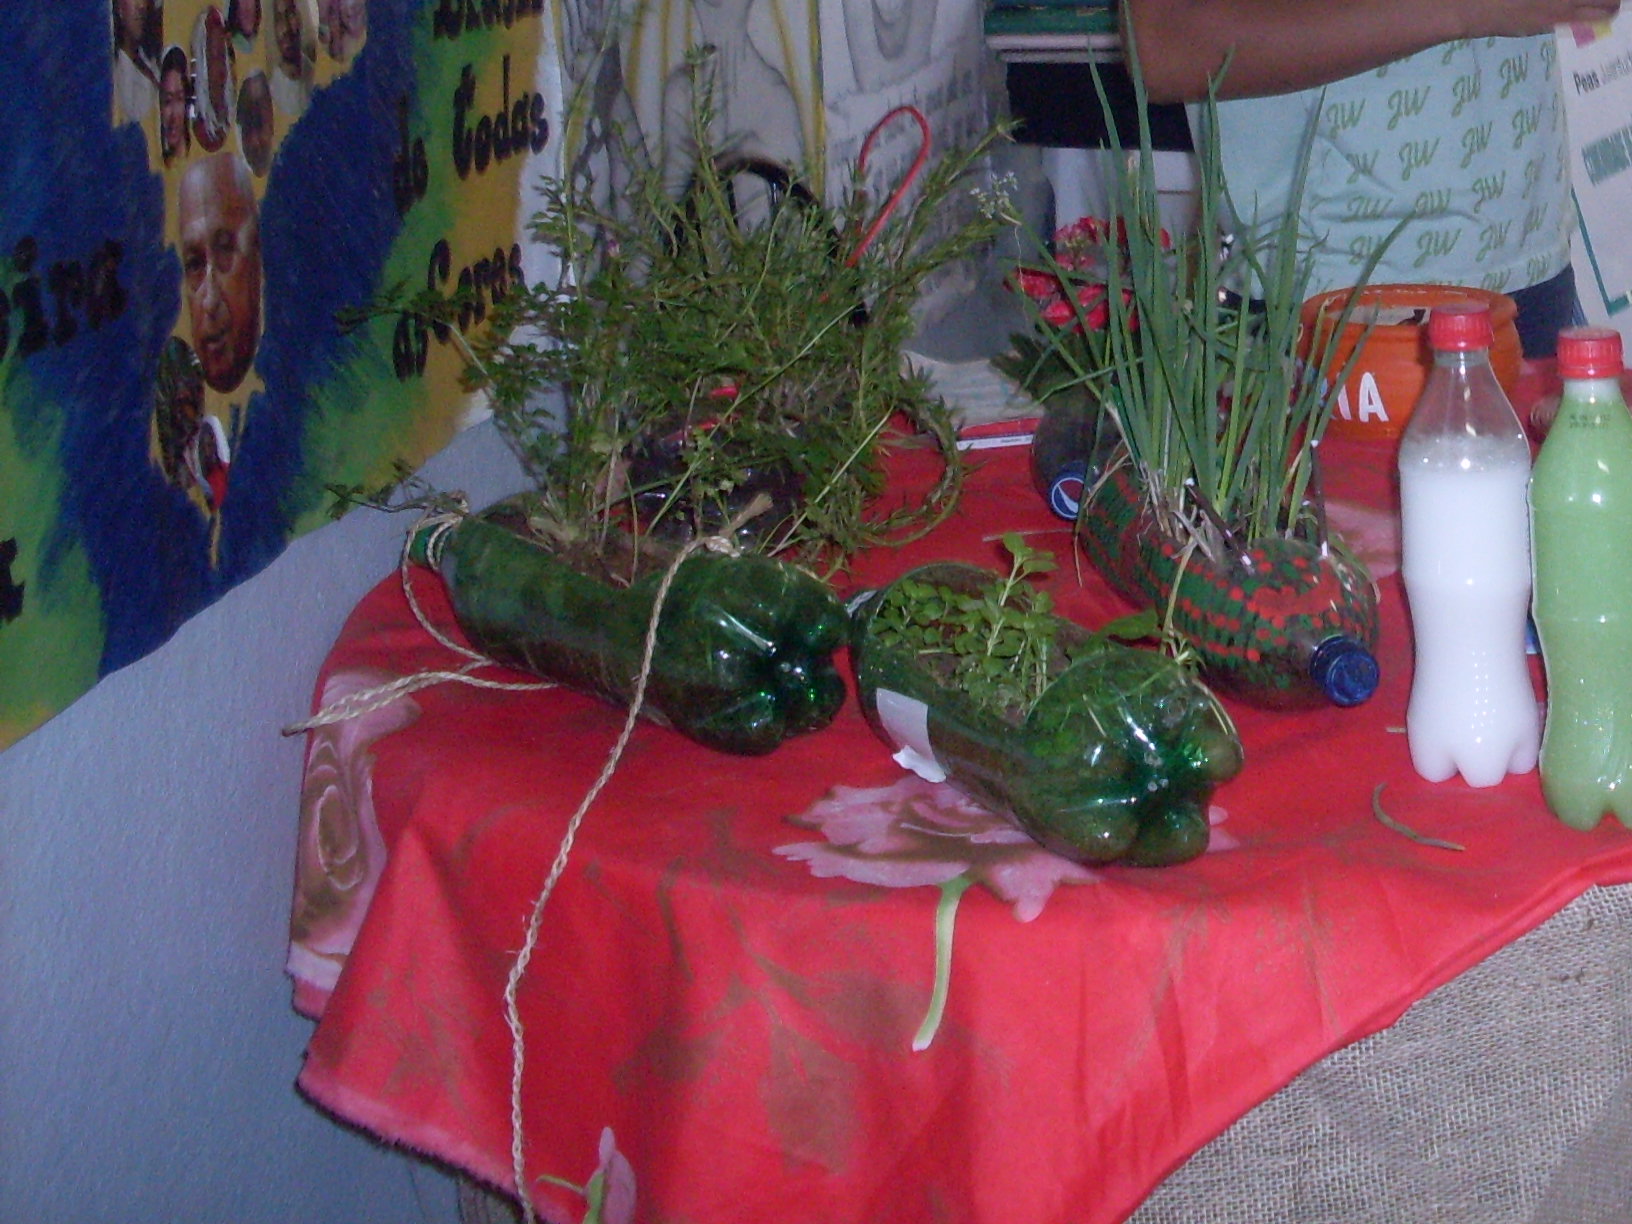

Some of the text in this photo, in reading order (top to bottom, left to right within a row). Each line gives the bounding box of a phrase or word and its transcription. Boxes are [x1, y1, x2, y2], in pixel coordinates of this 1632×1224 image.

[1573, 69, 1600, 96] Peas
[1326, 98, 1366, 139] JW
[1387, 85, 1431, 131] JW
[1399, 136, 1441, 181] JW
[1461, 121, 1493, 169] JW
[1472, 170, 1506, 214] JW
[1413, 228, 1462, 269] JW
[0, 236, 127, 356] ira
